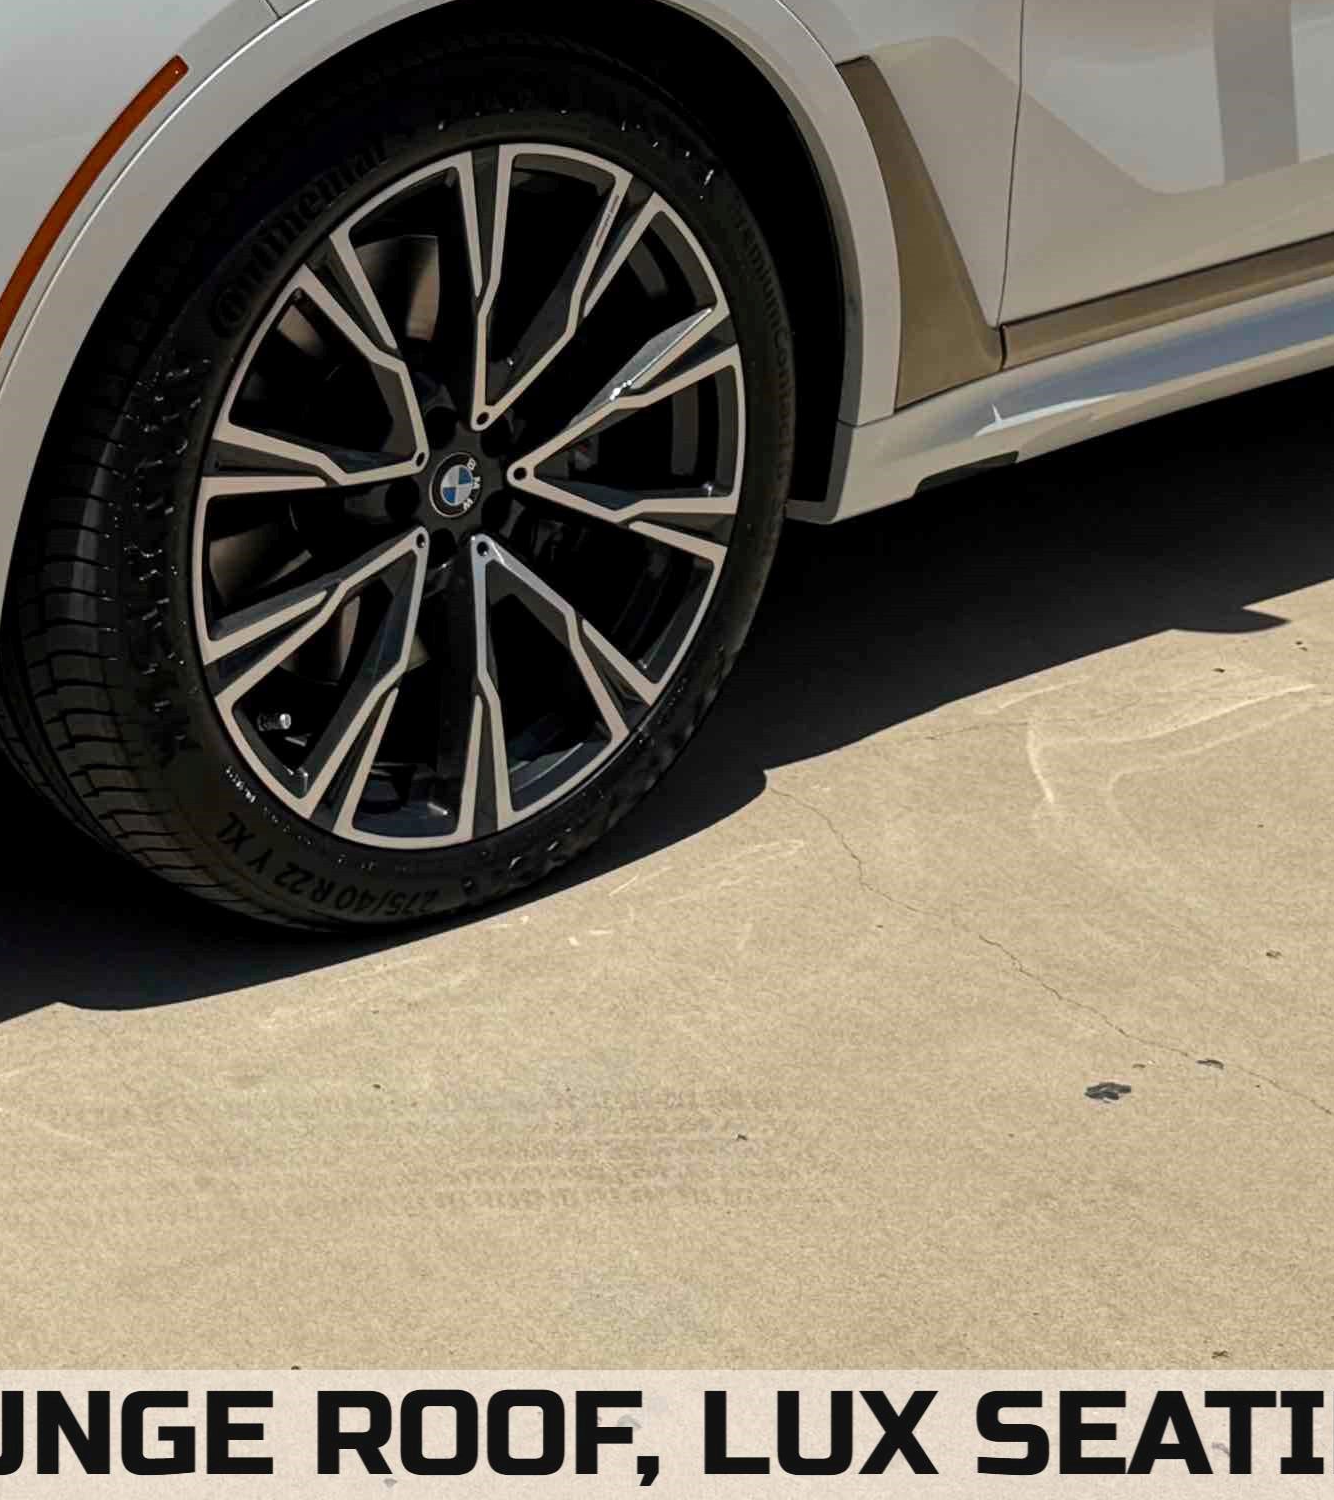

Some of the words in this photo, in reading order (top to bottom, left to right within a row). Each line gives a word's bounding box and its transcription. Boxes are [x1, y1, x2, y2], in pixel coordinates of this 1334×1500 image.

[217, 810, 255, 850] XL
[245, 848, 274, 875] Y
[334, 884, 439, 916] 275/40
